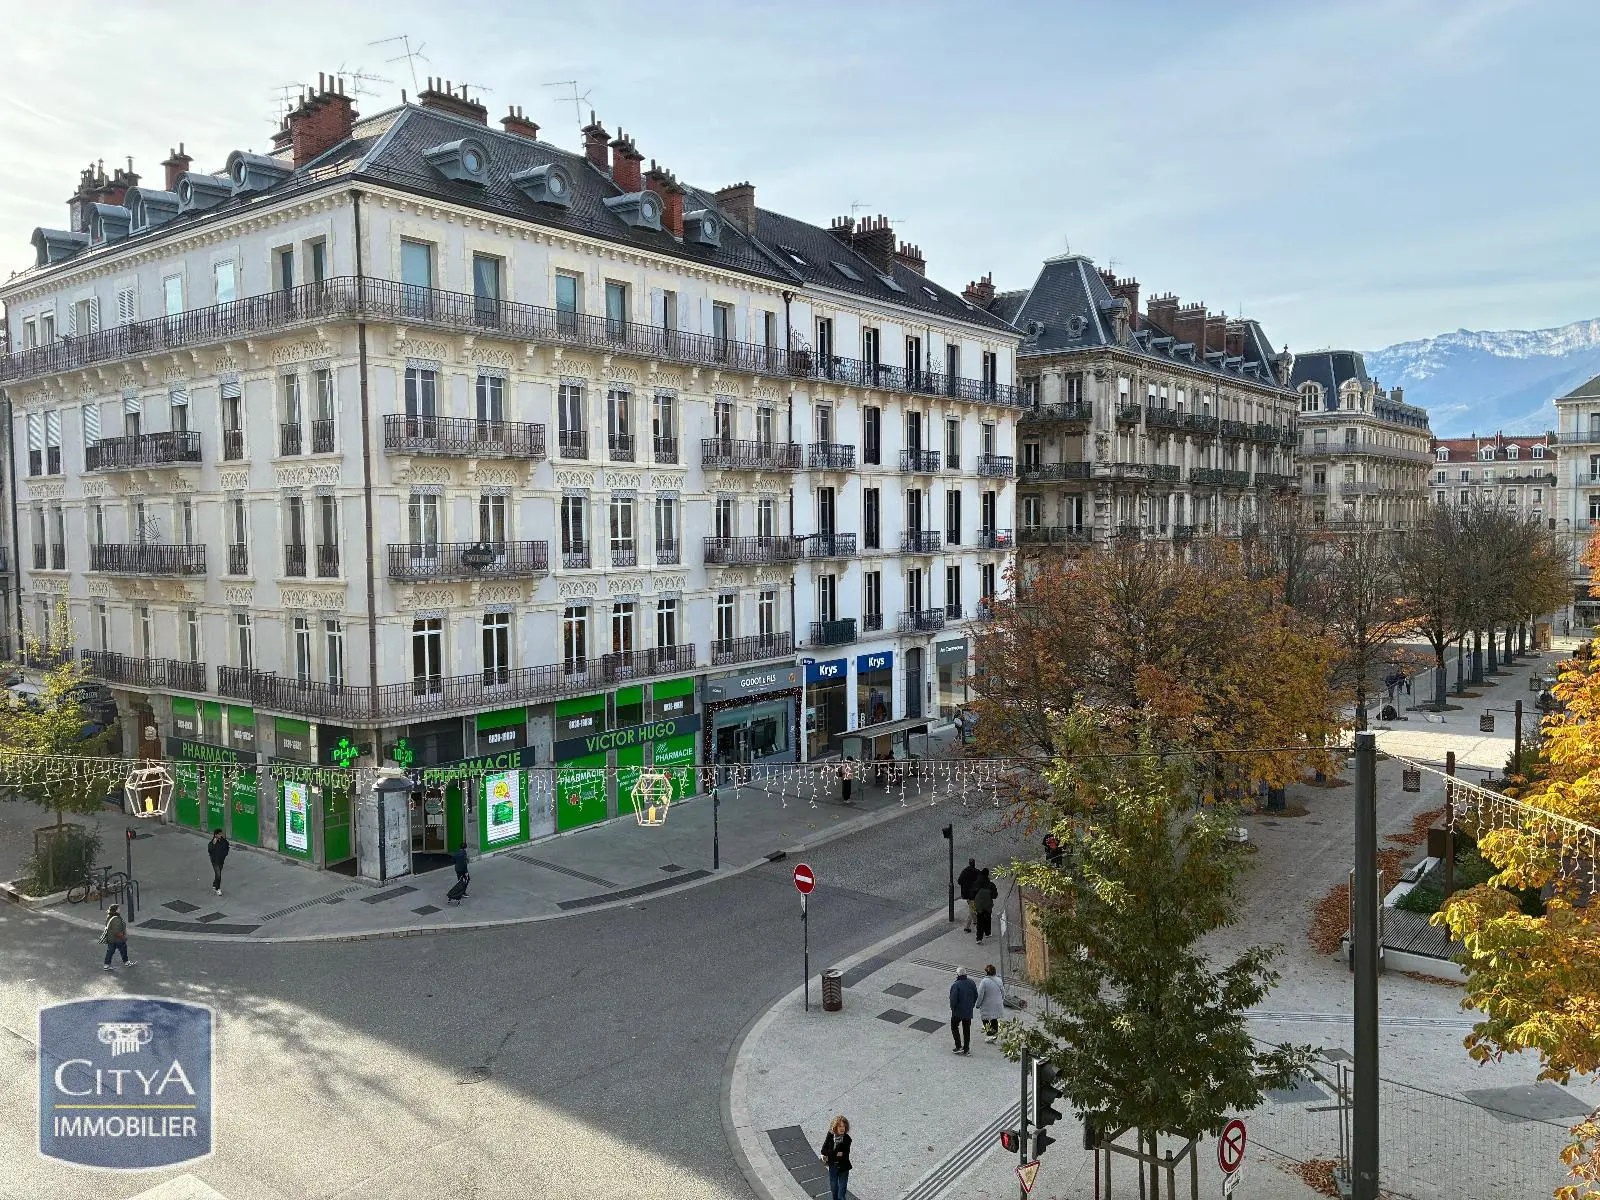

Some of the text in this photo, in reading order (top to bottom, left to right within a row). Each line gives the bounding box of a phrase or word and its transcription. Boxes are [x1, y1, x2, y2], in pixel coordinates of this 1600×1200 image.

[819, 664, 838, 676] Krys
[868, 656, 885, 668] Krys
[766, 674, 776, 683] FILS
[586, 729, 635, 752] VICTOR
[638, 721, 676, 742] HUGO
[182, 742, 238, 763] PHARMACIE
[333, 746, 359, 760] PHA
[655, 747, 694, 763] PHARMACIE
[423, 751, 521, 785] PHARMACIE
[559, 768, 606, 785] PHARMACIE
